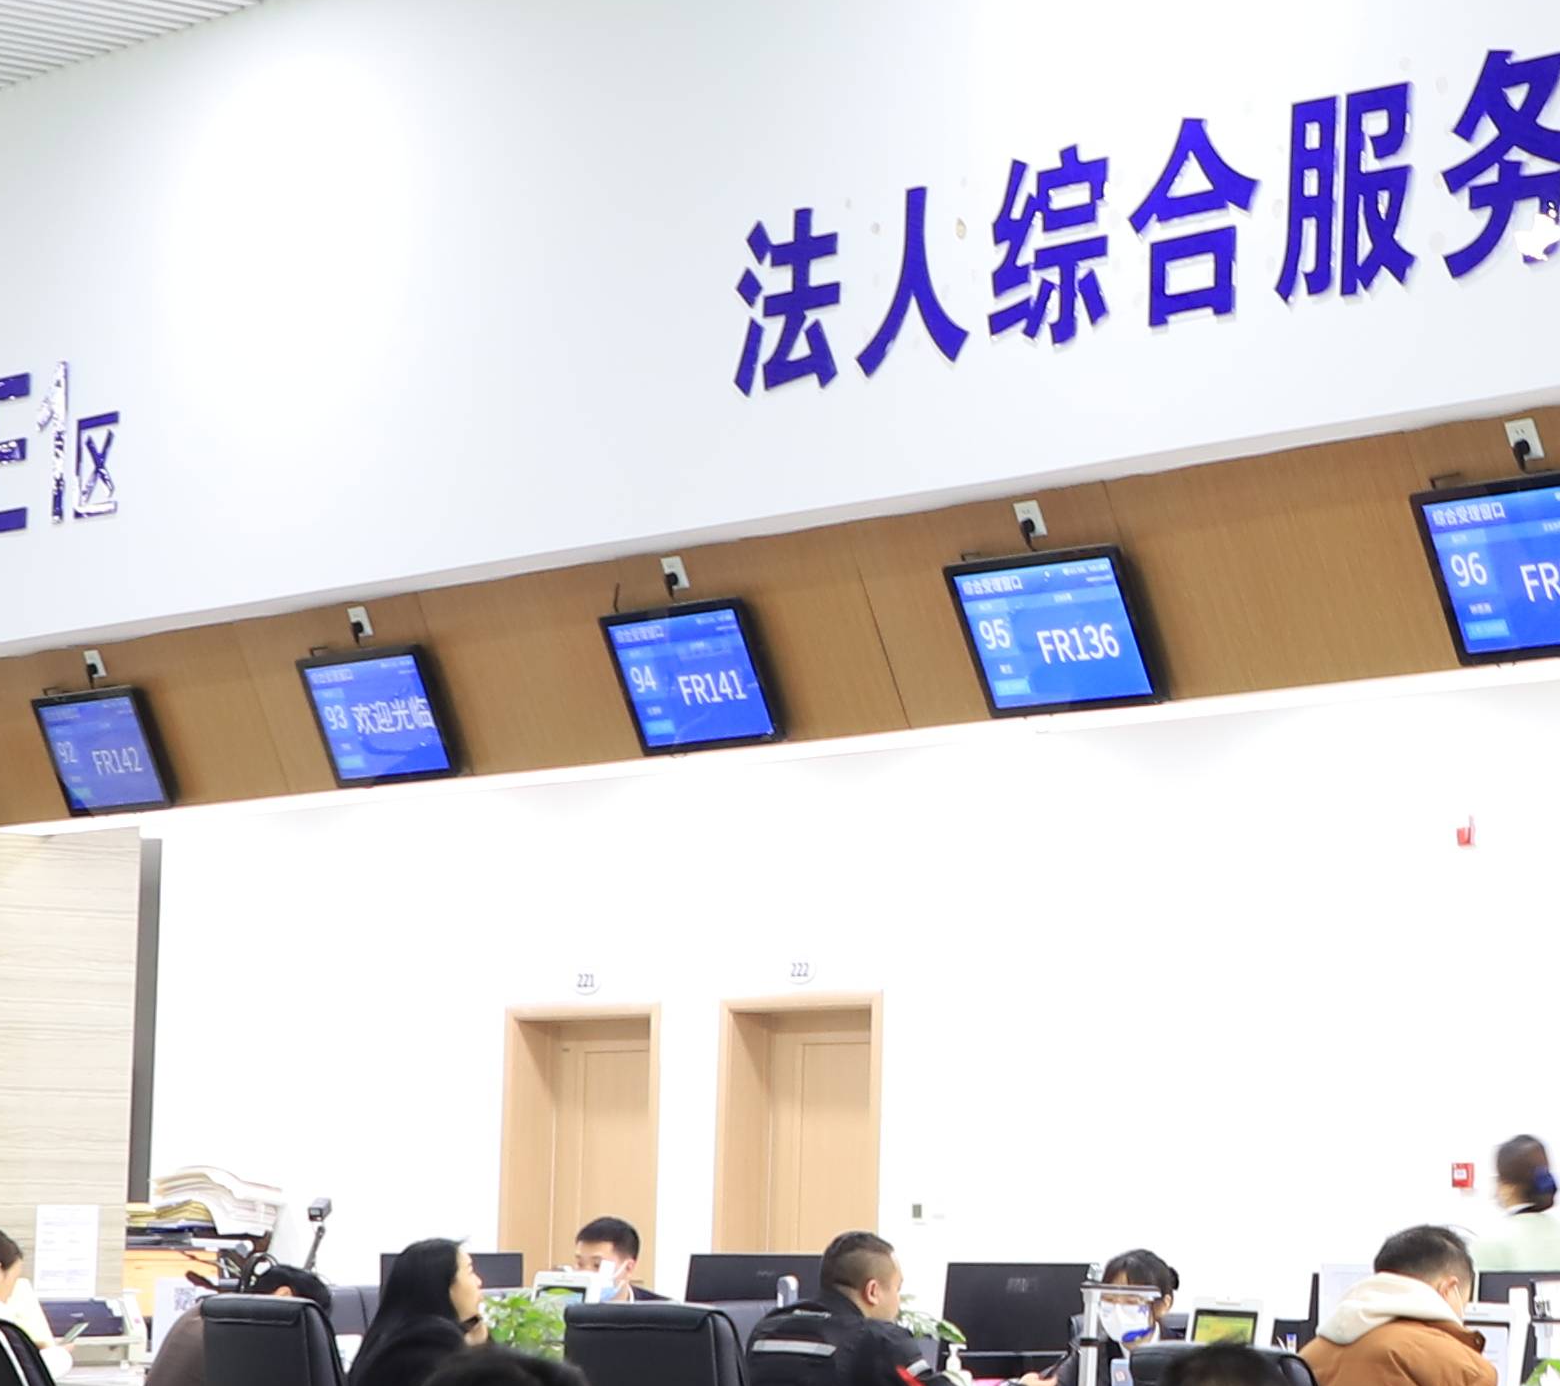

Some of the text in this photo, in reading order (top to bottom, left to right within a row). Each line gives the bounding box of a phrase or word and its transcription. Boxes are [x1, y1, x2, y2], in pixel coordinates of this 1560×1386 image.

[1451, 551, 1488, 588] 96
[979, 618, 1011, 650] 95
[1037, 623, 1121, 664] FR136
[630, 665, 657, 693] 94
[677, 669, 748, 706] FR141
[324, 706, 348, 730] 93
[351, 696, 436, 735] 欢迎光临
[92, 746, 144, 776] FR142
